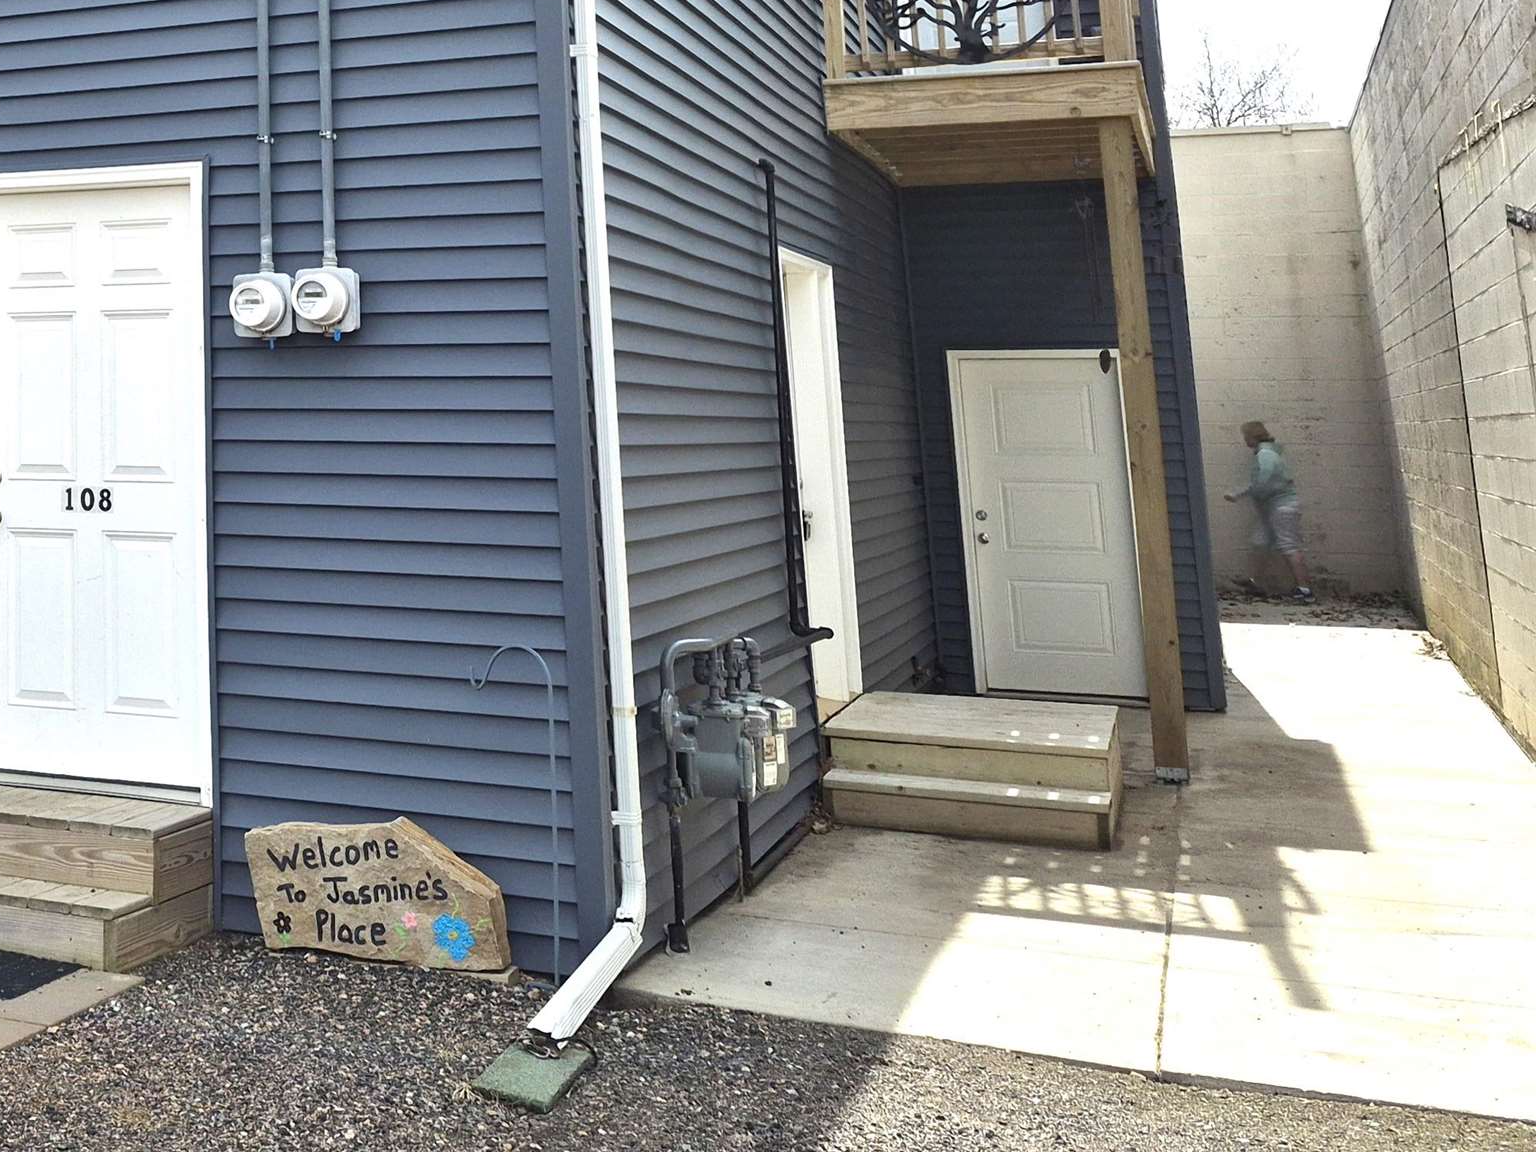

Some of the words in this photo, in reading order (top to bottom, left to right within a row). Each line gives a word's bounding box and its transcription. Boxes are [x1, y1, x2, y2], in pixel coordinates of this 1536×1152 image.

[65, 487, 112, 512] 108
[266, 836, 399, 872] Welcome
[276, 883, 307, 903] To
[322, 871, 449, 905] Jasmine's
[315, 908, 386, 946] Place
